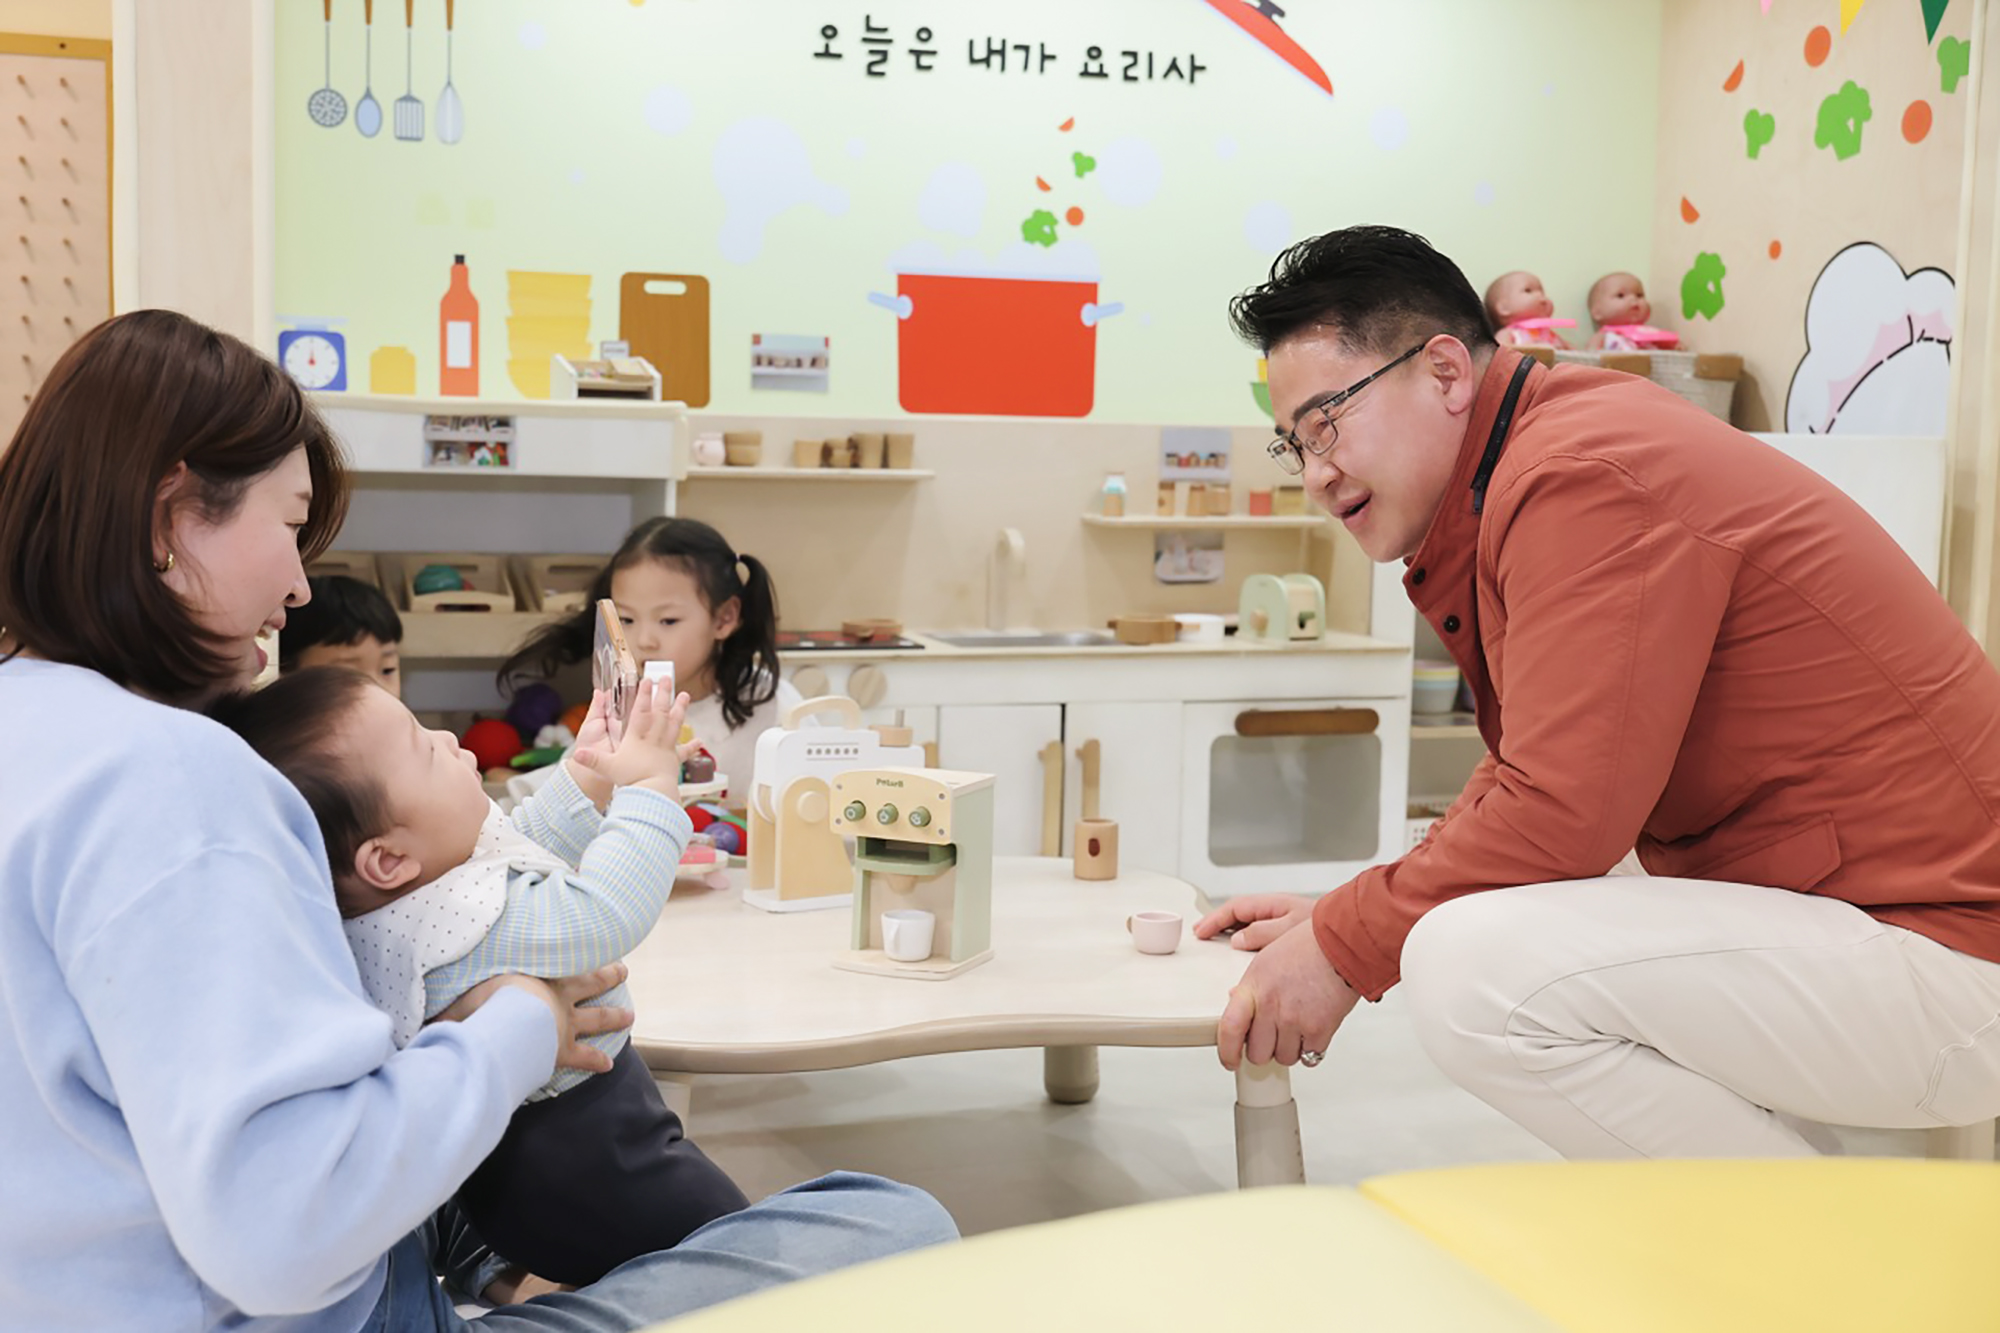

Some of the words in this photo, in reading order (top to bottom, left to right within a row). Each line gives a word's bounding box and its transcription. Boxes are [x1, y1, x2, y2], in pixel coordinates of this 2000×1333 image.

[813, 14, 939, 78] 오늘은
[967, 36, 1057, 74] 내가
[1078, 44, 1208, 85] 요리사
